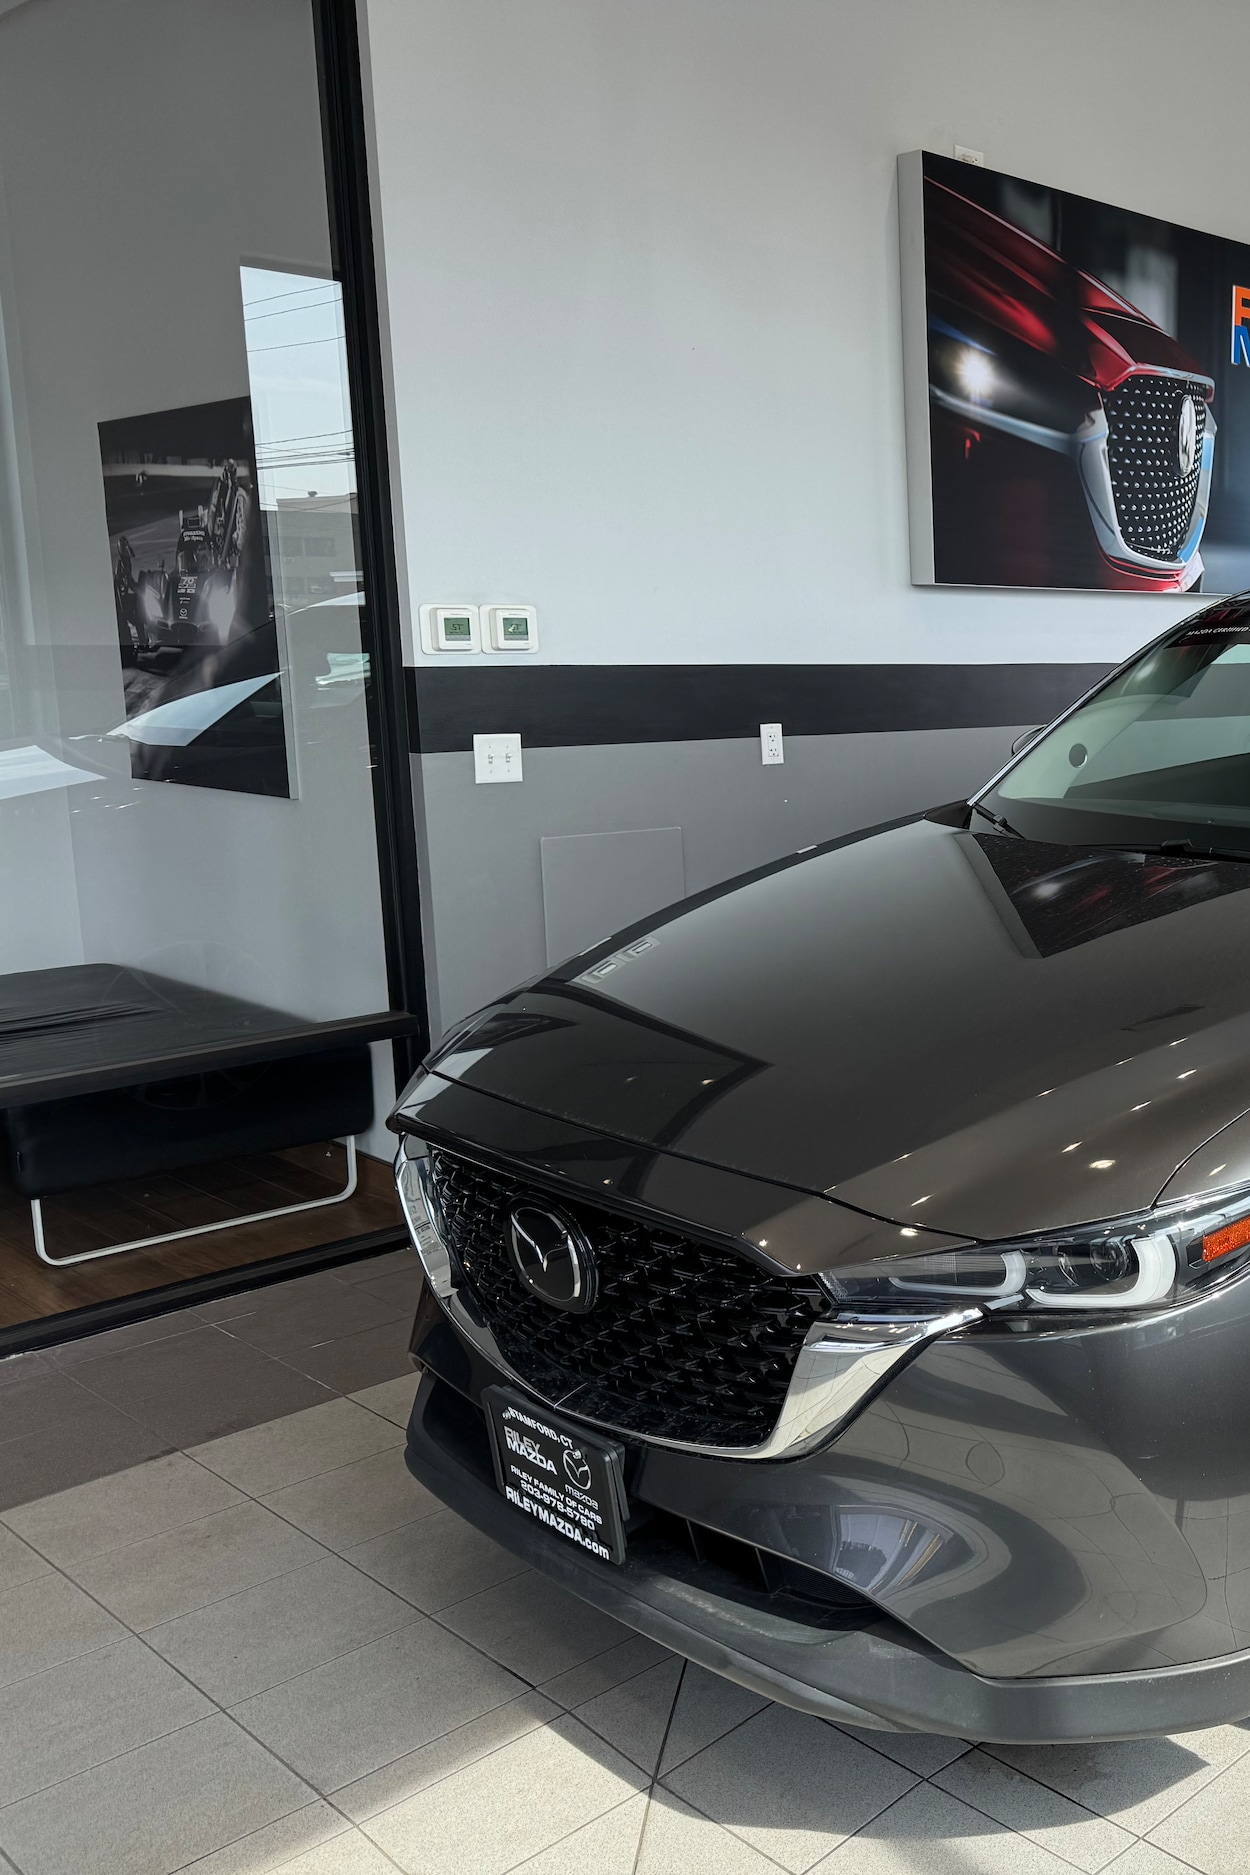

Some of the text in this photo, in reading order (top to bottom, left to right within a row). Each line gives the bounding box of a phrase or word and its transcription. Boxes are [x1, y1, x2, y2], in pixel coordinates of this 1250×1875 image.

[504, 1425, 540, 1454] RILEY
[506, 1436, 558, 1475] MAZDA
[510, 1464, 603, 1525] RILEY FAMILY OF CARS
[564, 1483, 599, 1511] mazda
[505, 1485, 610, 1561] RILEYMAZDA.com
